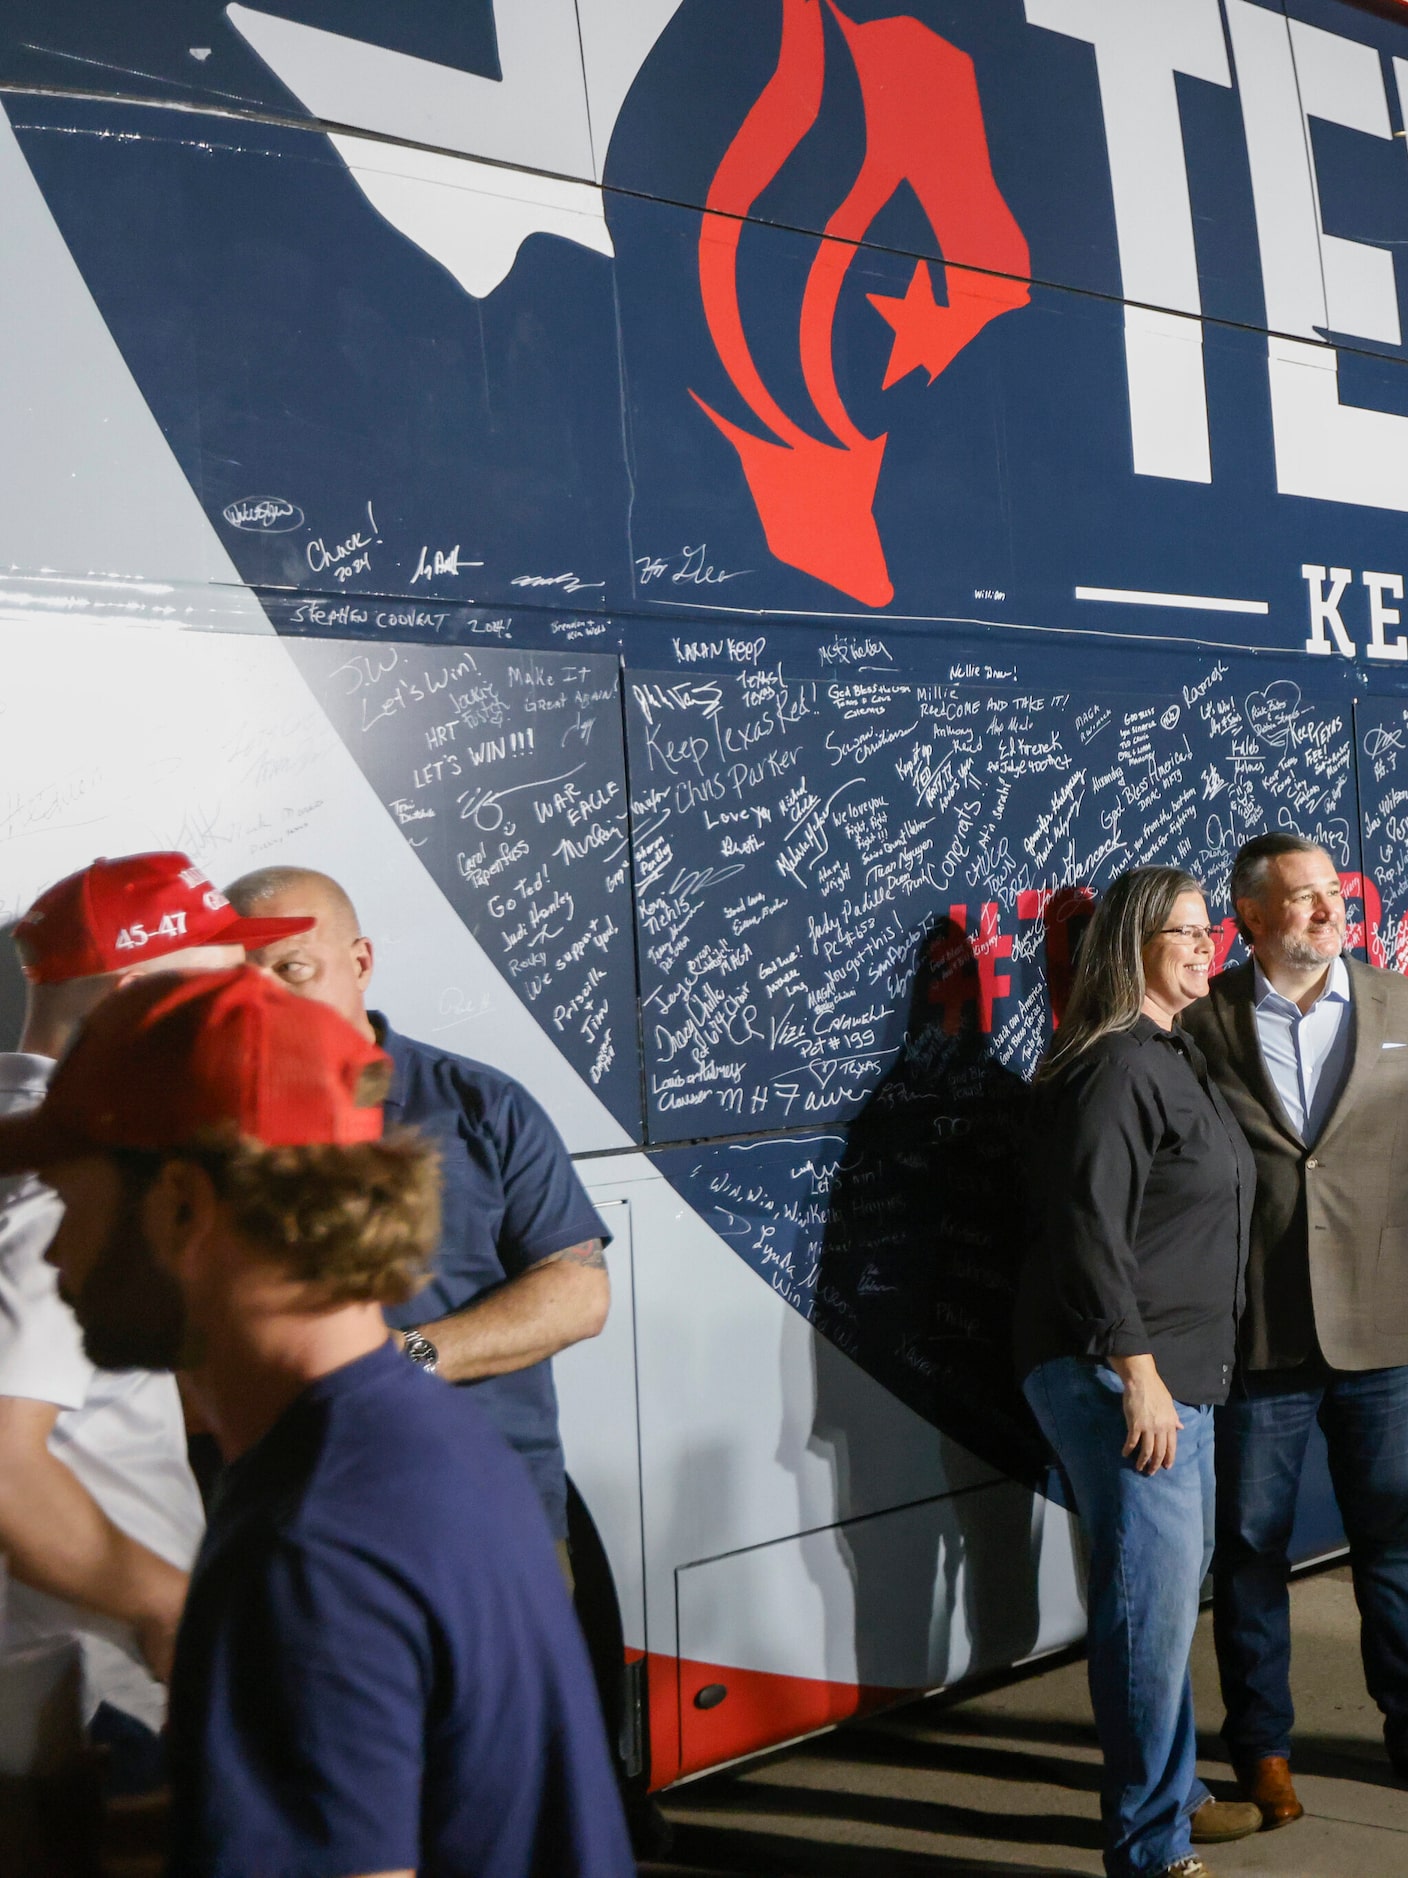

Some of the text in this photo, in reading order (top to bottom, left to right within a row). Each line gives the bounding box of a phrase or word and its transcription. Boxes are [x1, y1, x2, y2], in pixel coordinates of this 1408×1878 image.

[987, 697, 1008, 711] AND
[1012, 696, 1044, 712] TAKE
[413, 755, 462, 789] LET'S
[468, 728, 534, 766] WIN!!!
[533, 783, 581, 823] WAR
[115, 911, 188, 951] 45-47
